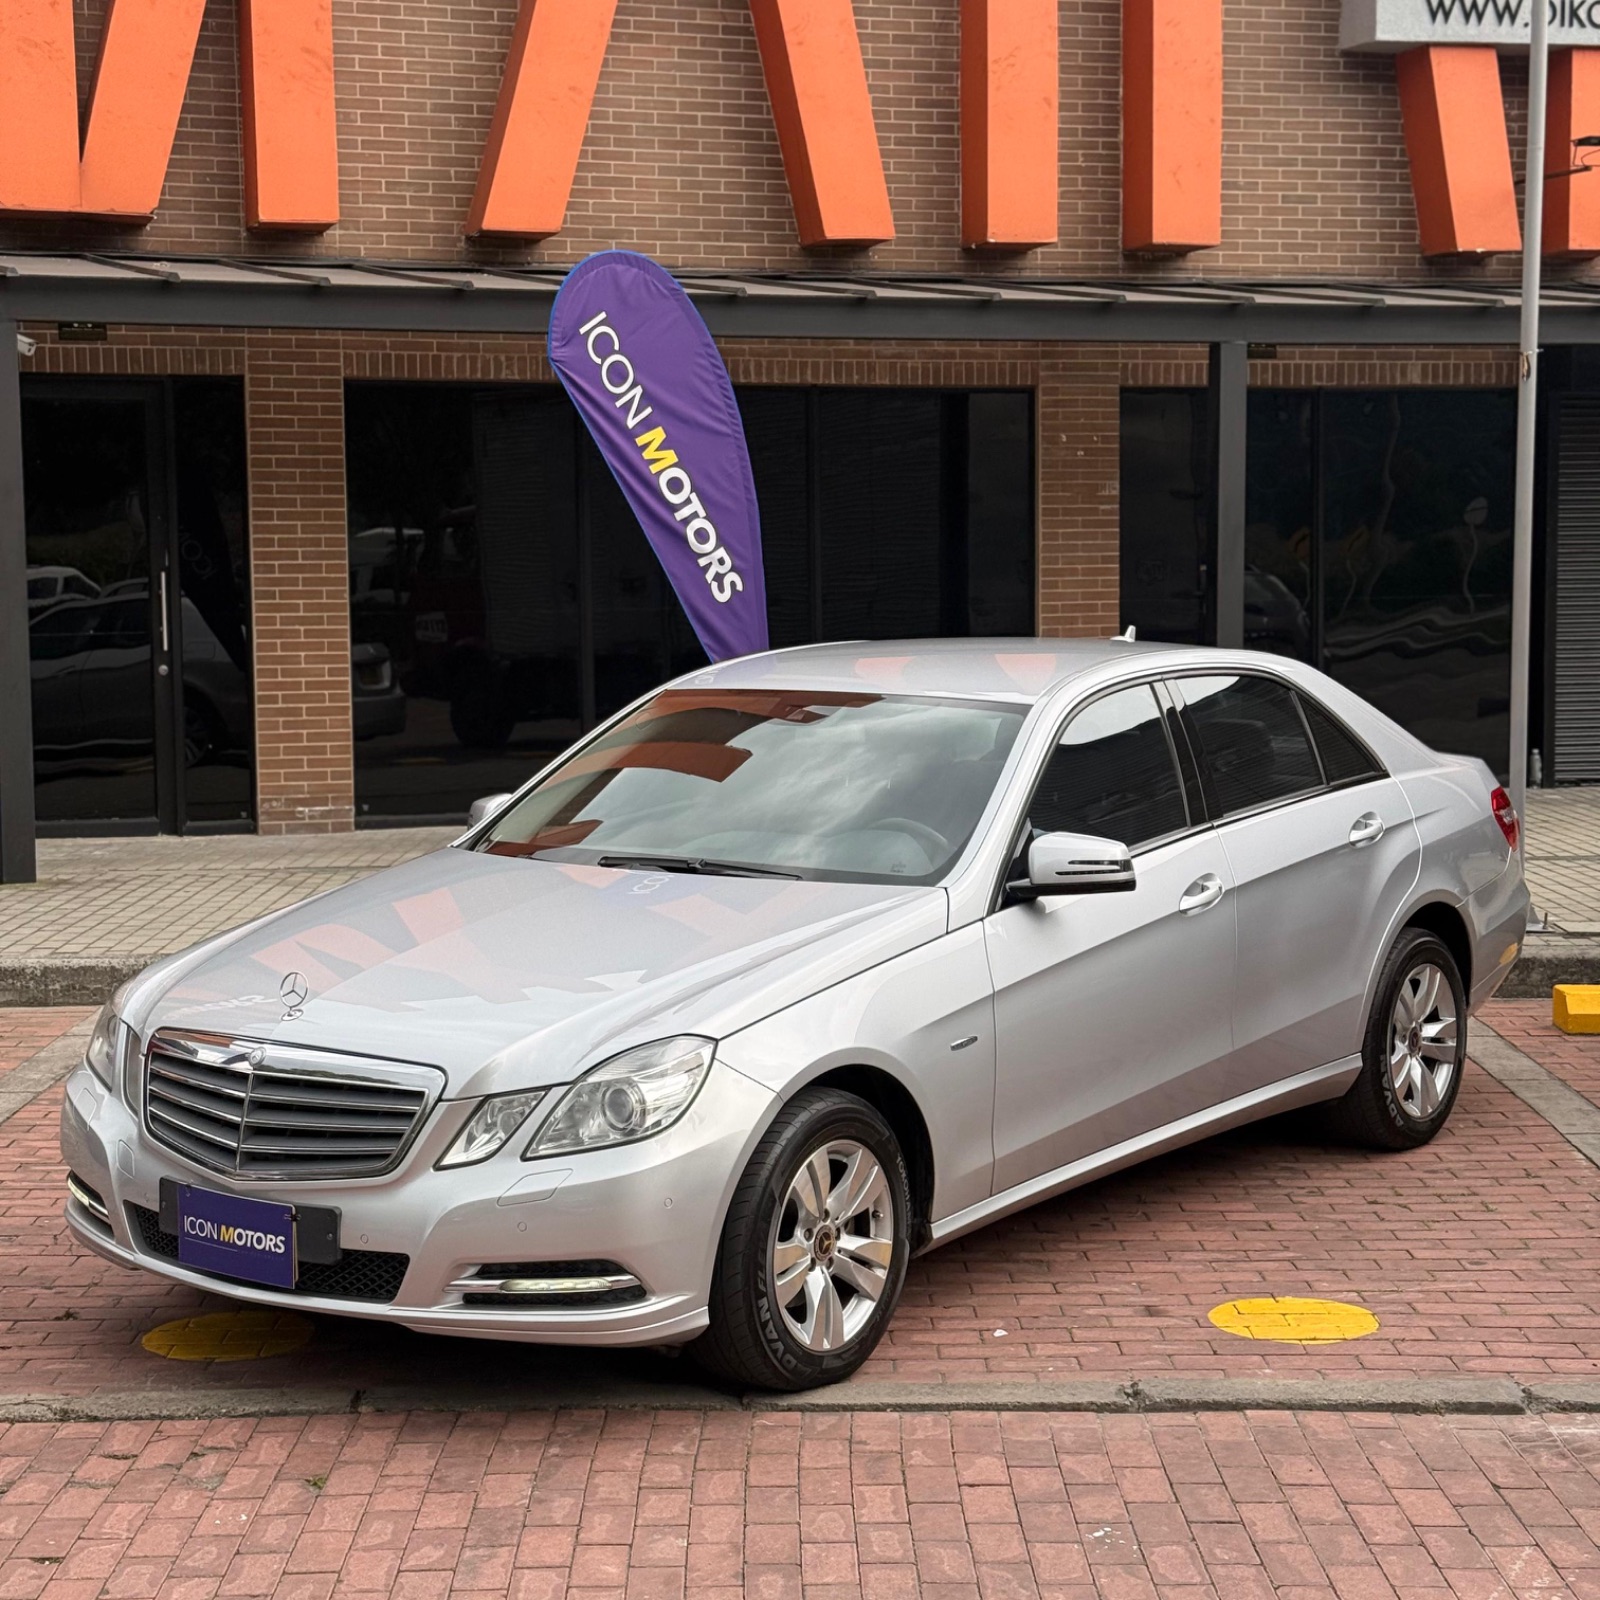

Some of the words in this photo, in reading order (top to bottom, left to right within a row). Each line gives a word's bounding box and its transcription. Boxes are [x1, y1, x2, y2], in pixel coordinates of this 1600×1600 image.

[578, 311, 653, 430] ICON
[634, 425, 744, 603] MOTORS
[1379, 1054, 1404, 1127] ADVAN
[183, 1215, 218, 1240] ICON
[220, 1225, 286, 1254] MOTORS
